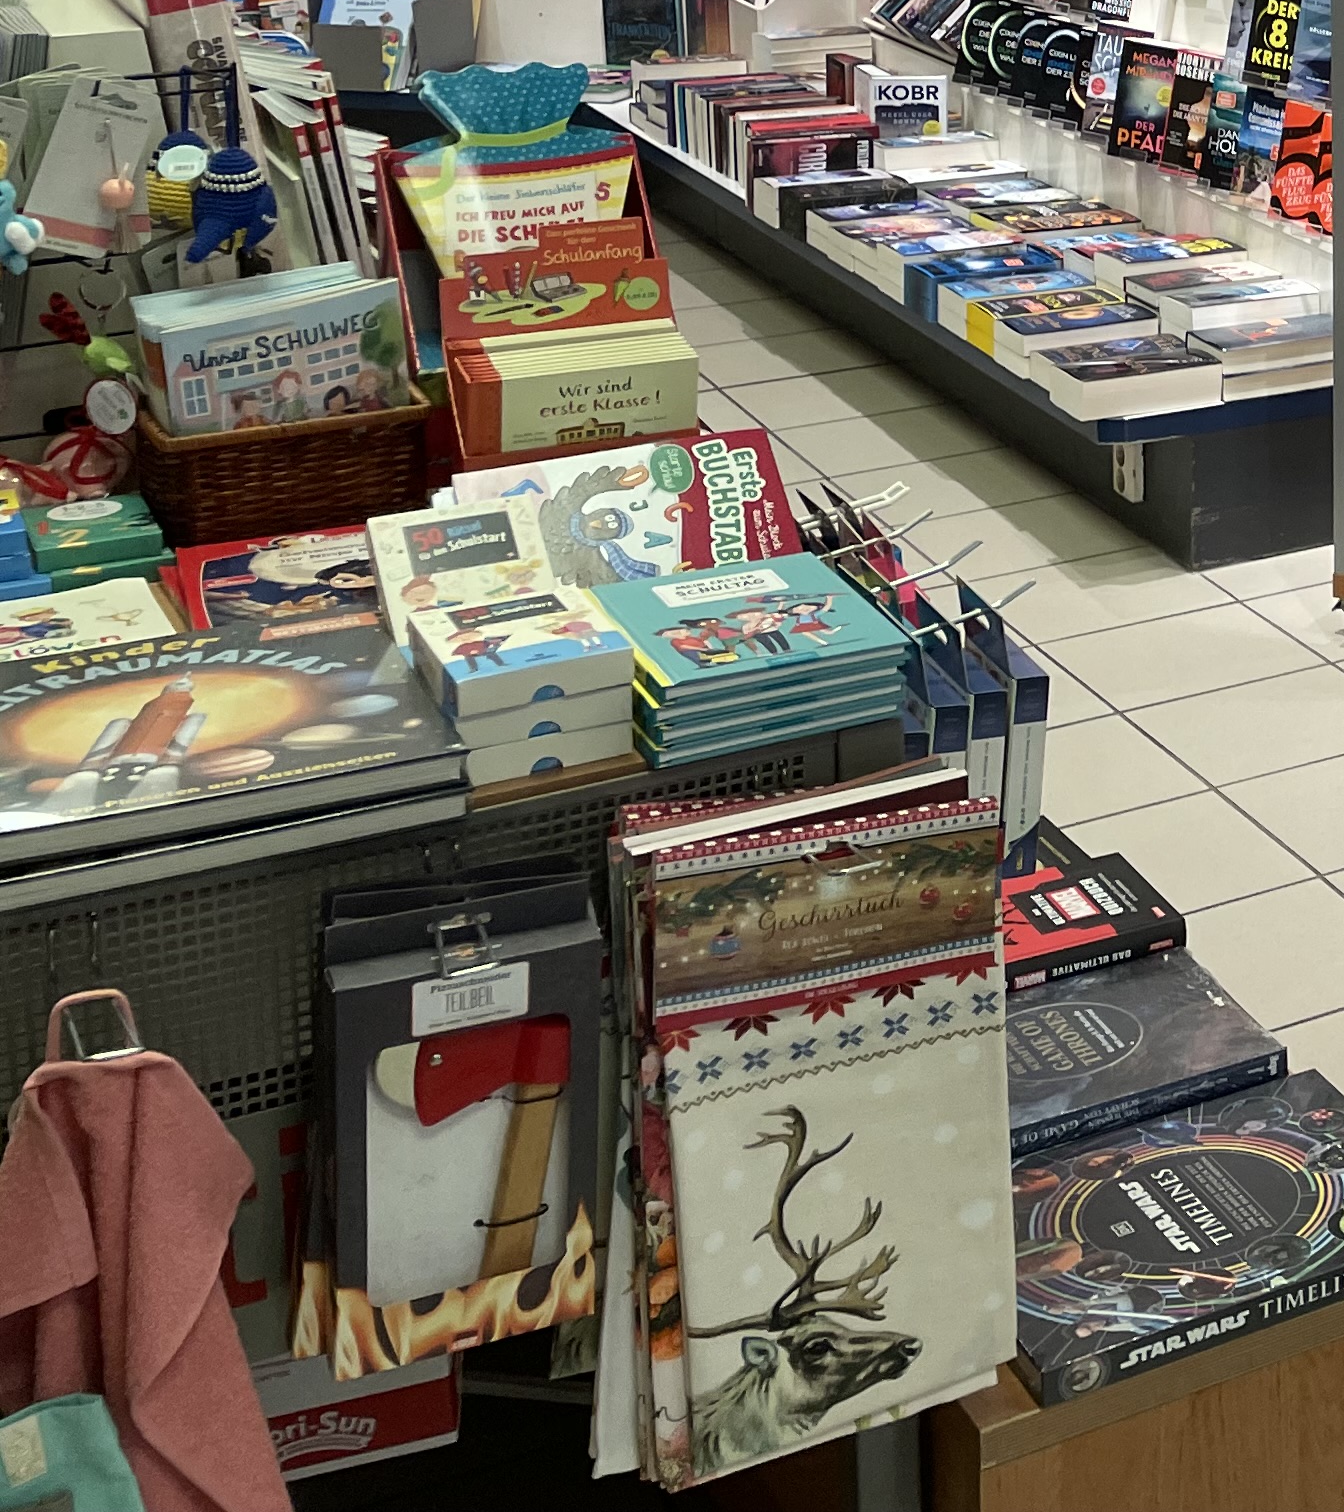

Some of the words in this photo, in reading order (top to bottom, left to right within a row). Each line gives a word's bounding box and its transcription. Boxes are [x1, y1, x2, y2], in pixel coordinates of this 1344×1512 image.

[1266, 0, 1301, 20] DER
[1132, 50, 1177, 68] MEGAN
[878, 84, 940, 101] KOBR
[1135, 120, 1156, 134] DER
[456, 210, 479, 223] ICH
[484, 208, 517, 222] FREU
[522, 204, 556, 218] MICH
[560, 201, 585, 215] AUF
[457, 228, 486, 243] DIE
[543, 243, 644, 267] Schulanfang
[184, 341, 251, 370] Unser
[254, 309, 381, 359] SCHULWEG
[559, 383, 591, 399] Wir
[596, 376, 633, 394] sind
[539, 399, 588, 419] erste
[731, 450, 759, 499] Erste
[413, 528, 443, 548] 50
[447, 530, 507, 552] Schulstart
[676, 578, 766, 598] SCHULTAG
[31, 636, 221, 674] Kinder
[758, 892, 904, 936] Geschirrtuch
[1051, 953, 1111, 977] ULTIMATIVE
[1112, 948, 1132, 960] DAS
[443, 984, 495, 1010] TEILBEIL
[1014, 1020, 1044, 1039] OF
[1038, 1009, 1104, 1068] THRONES
[1031, 1037, 1075, 1073] GAME
[1118, 1180, 1172, 1224] WARS
[1150, 1167, 1235, 1247] TIMELINES
[1157, 1218, 1201, 1255] STAR
[1121, 1335, 1186, 1370] STAR
[1186, 1310, 1250, 1346] WARS
